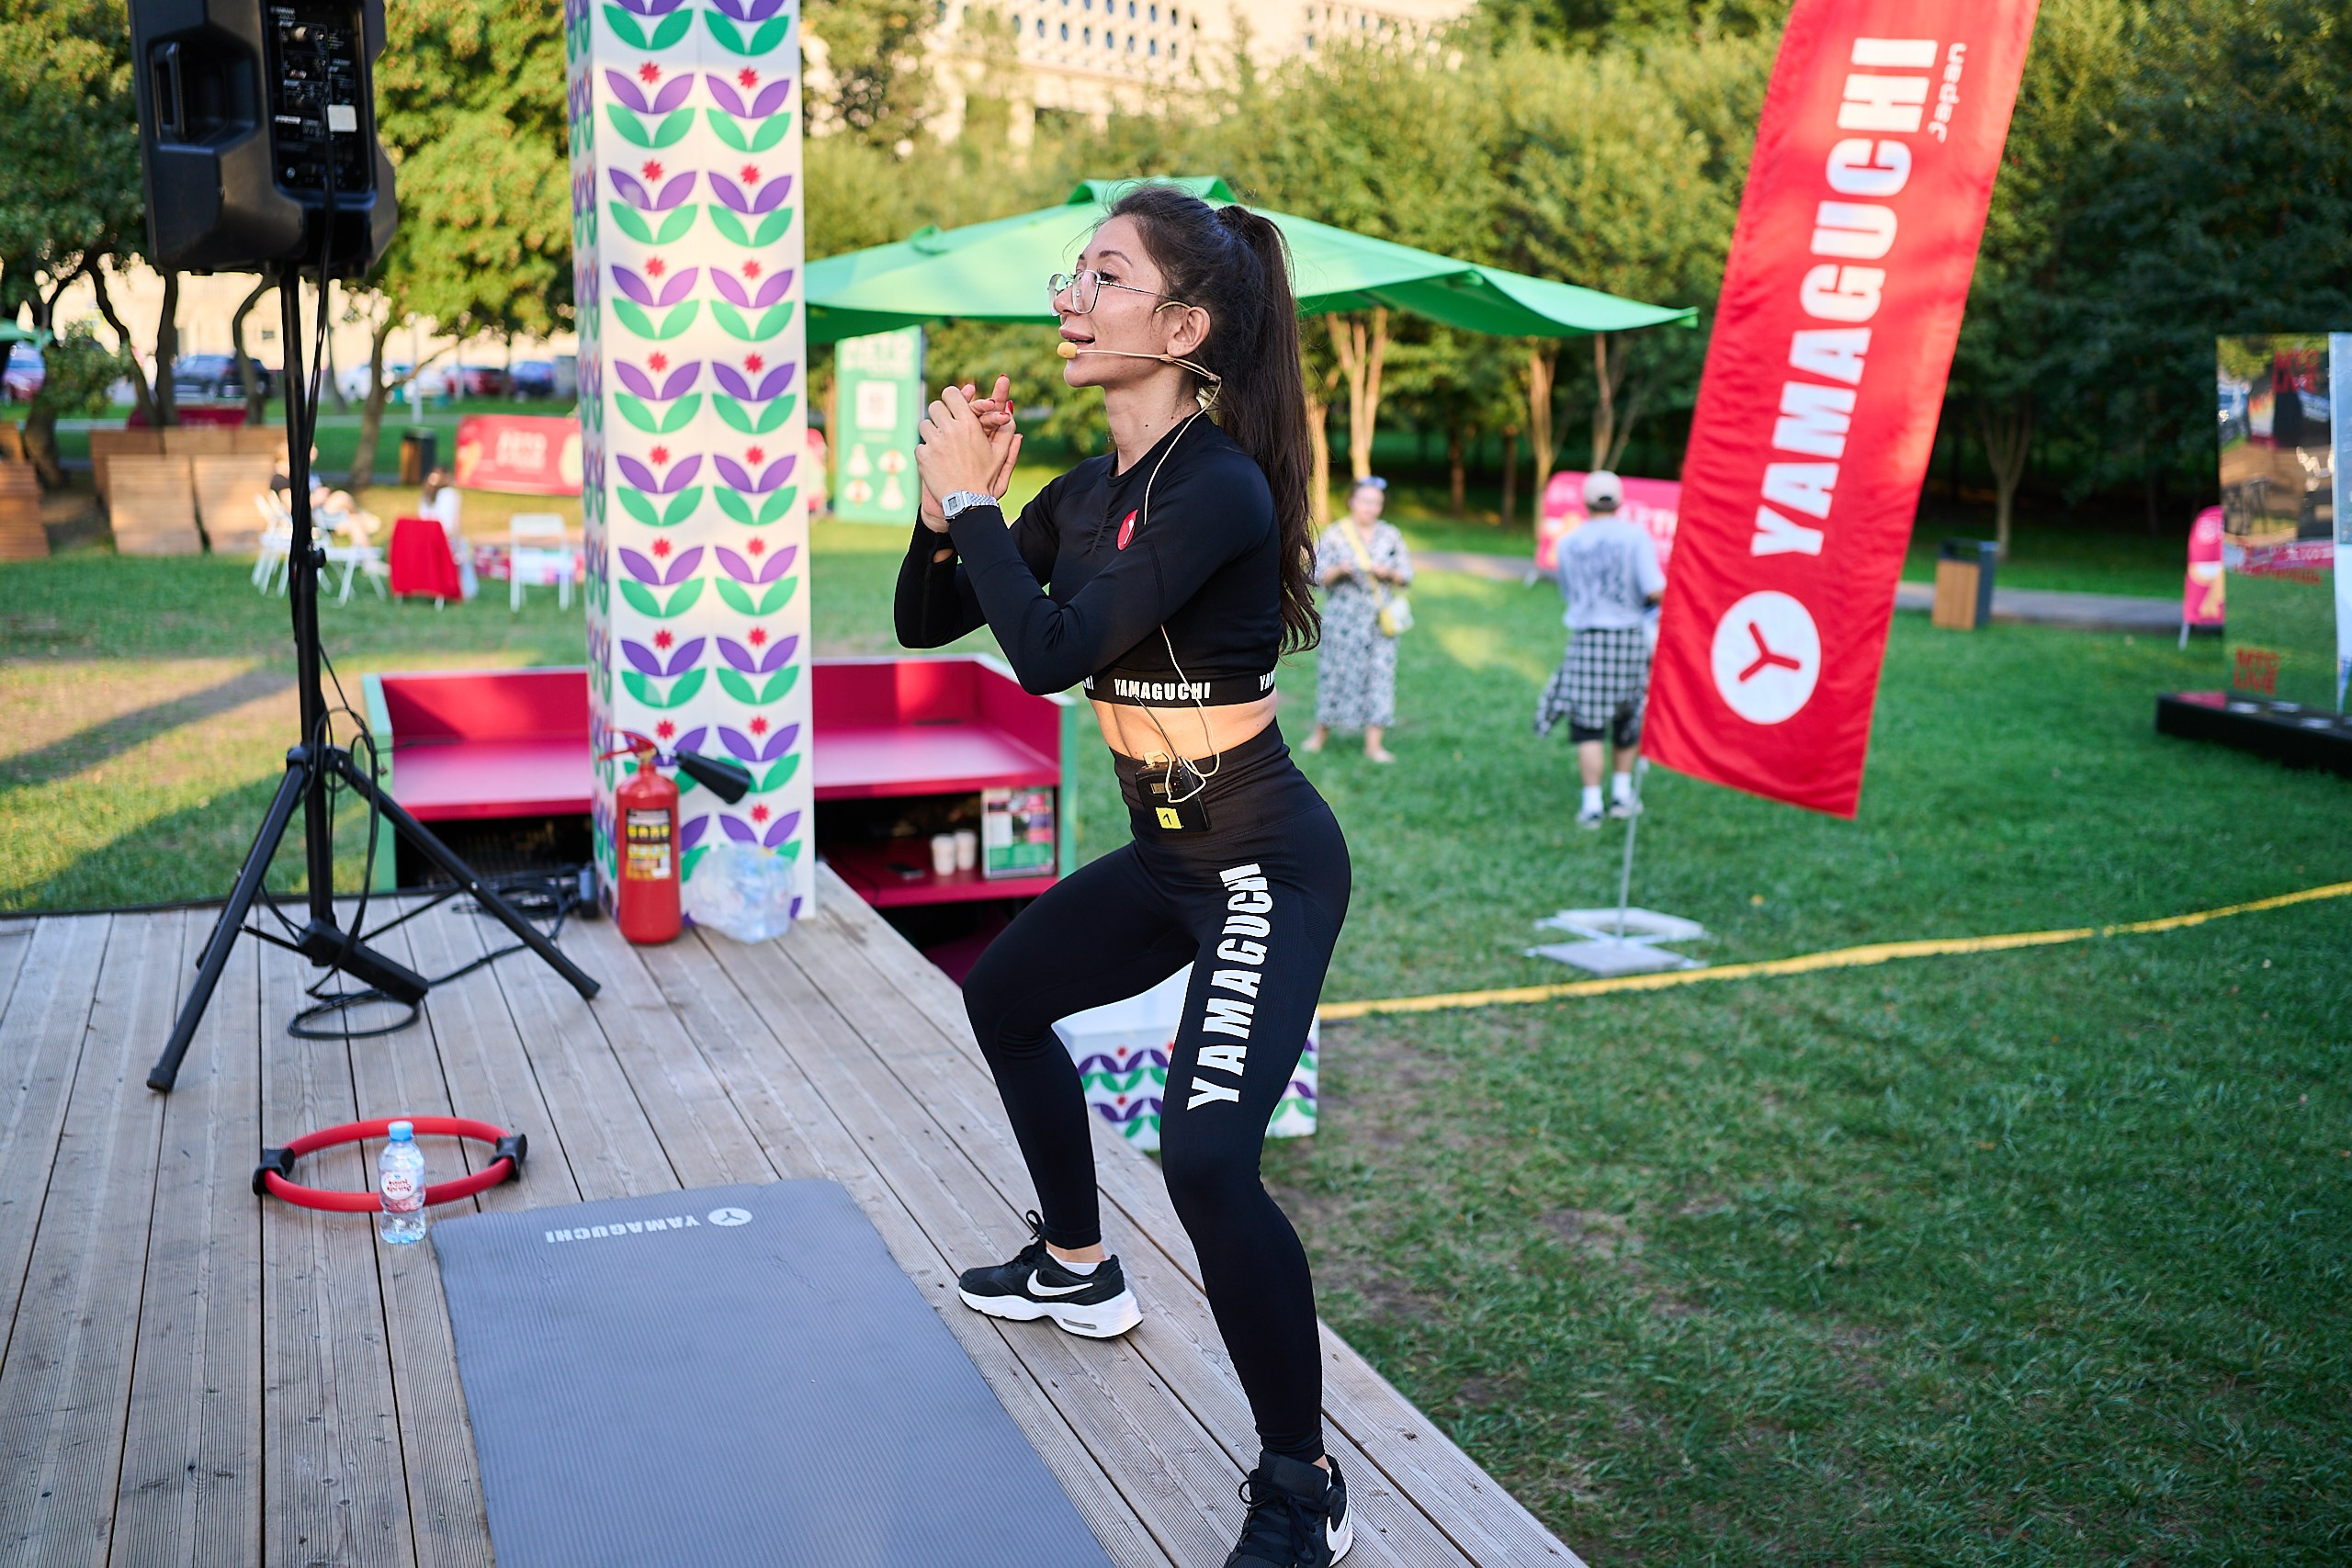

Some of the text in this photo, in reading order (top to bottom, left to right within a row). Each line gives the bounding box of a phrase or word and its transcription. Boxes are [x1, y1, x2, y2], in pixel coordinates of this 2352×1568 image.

[1928, 42, 1967, 143] Japan
[1749, 37, 1939, 558] YAMAGUCHI
[1114, 678, 1211, 701] YAMAGUCHI
[1162, 813, 1172, 826] 1
[1186, 863, 1273, 1111] YAMAGUCHI
[544, 1214, 702, 1244] YAMAGUCHI
